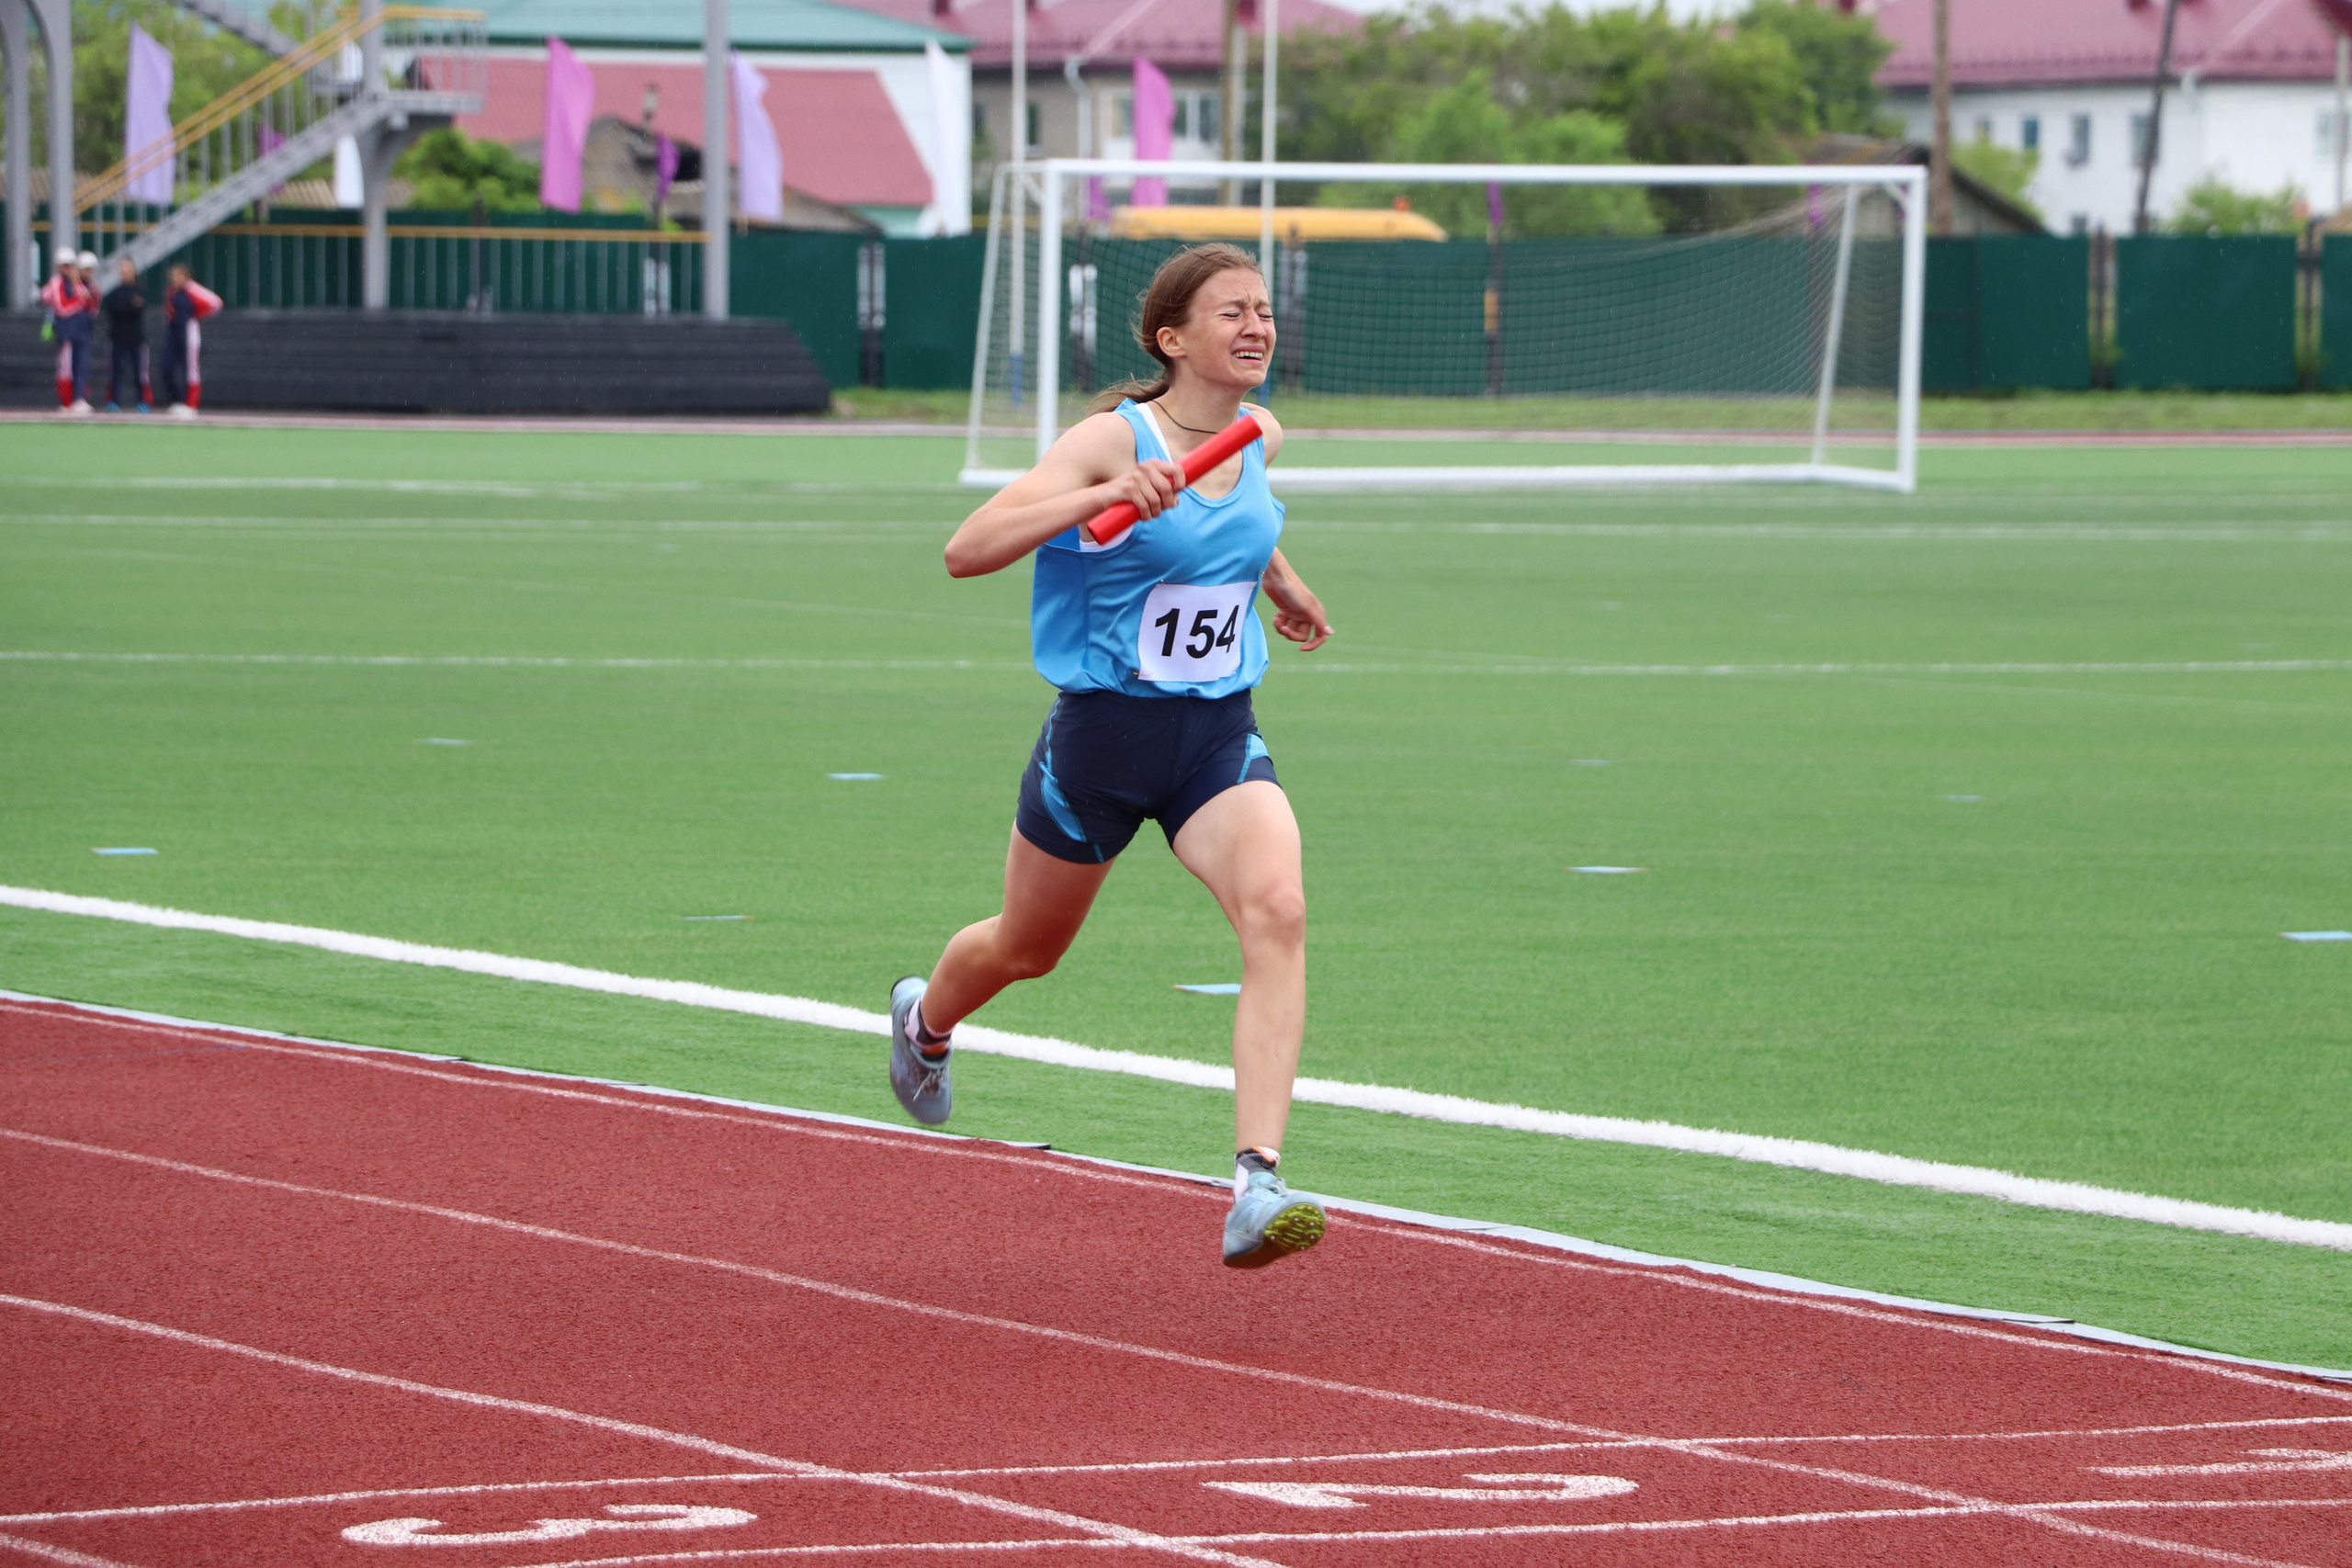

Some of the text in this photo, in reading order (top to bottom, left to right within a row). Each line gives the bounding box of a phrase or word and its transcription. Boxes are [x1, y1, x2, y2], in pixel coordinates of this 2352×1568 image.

[1155, 604, 1239, 659] 154
[1200, 1472, 1640, 1508] 2
[341, 1504, 758, 1545] 3
